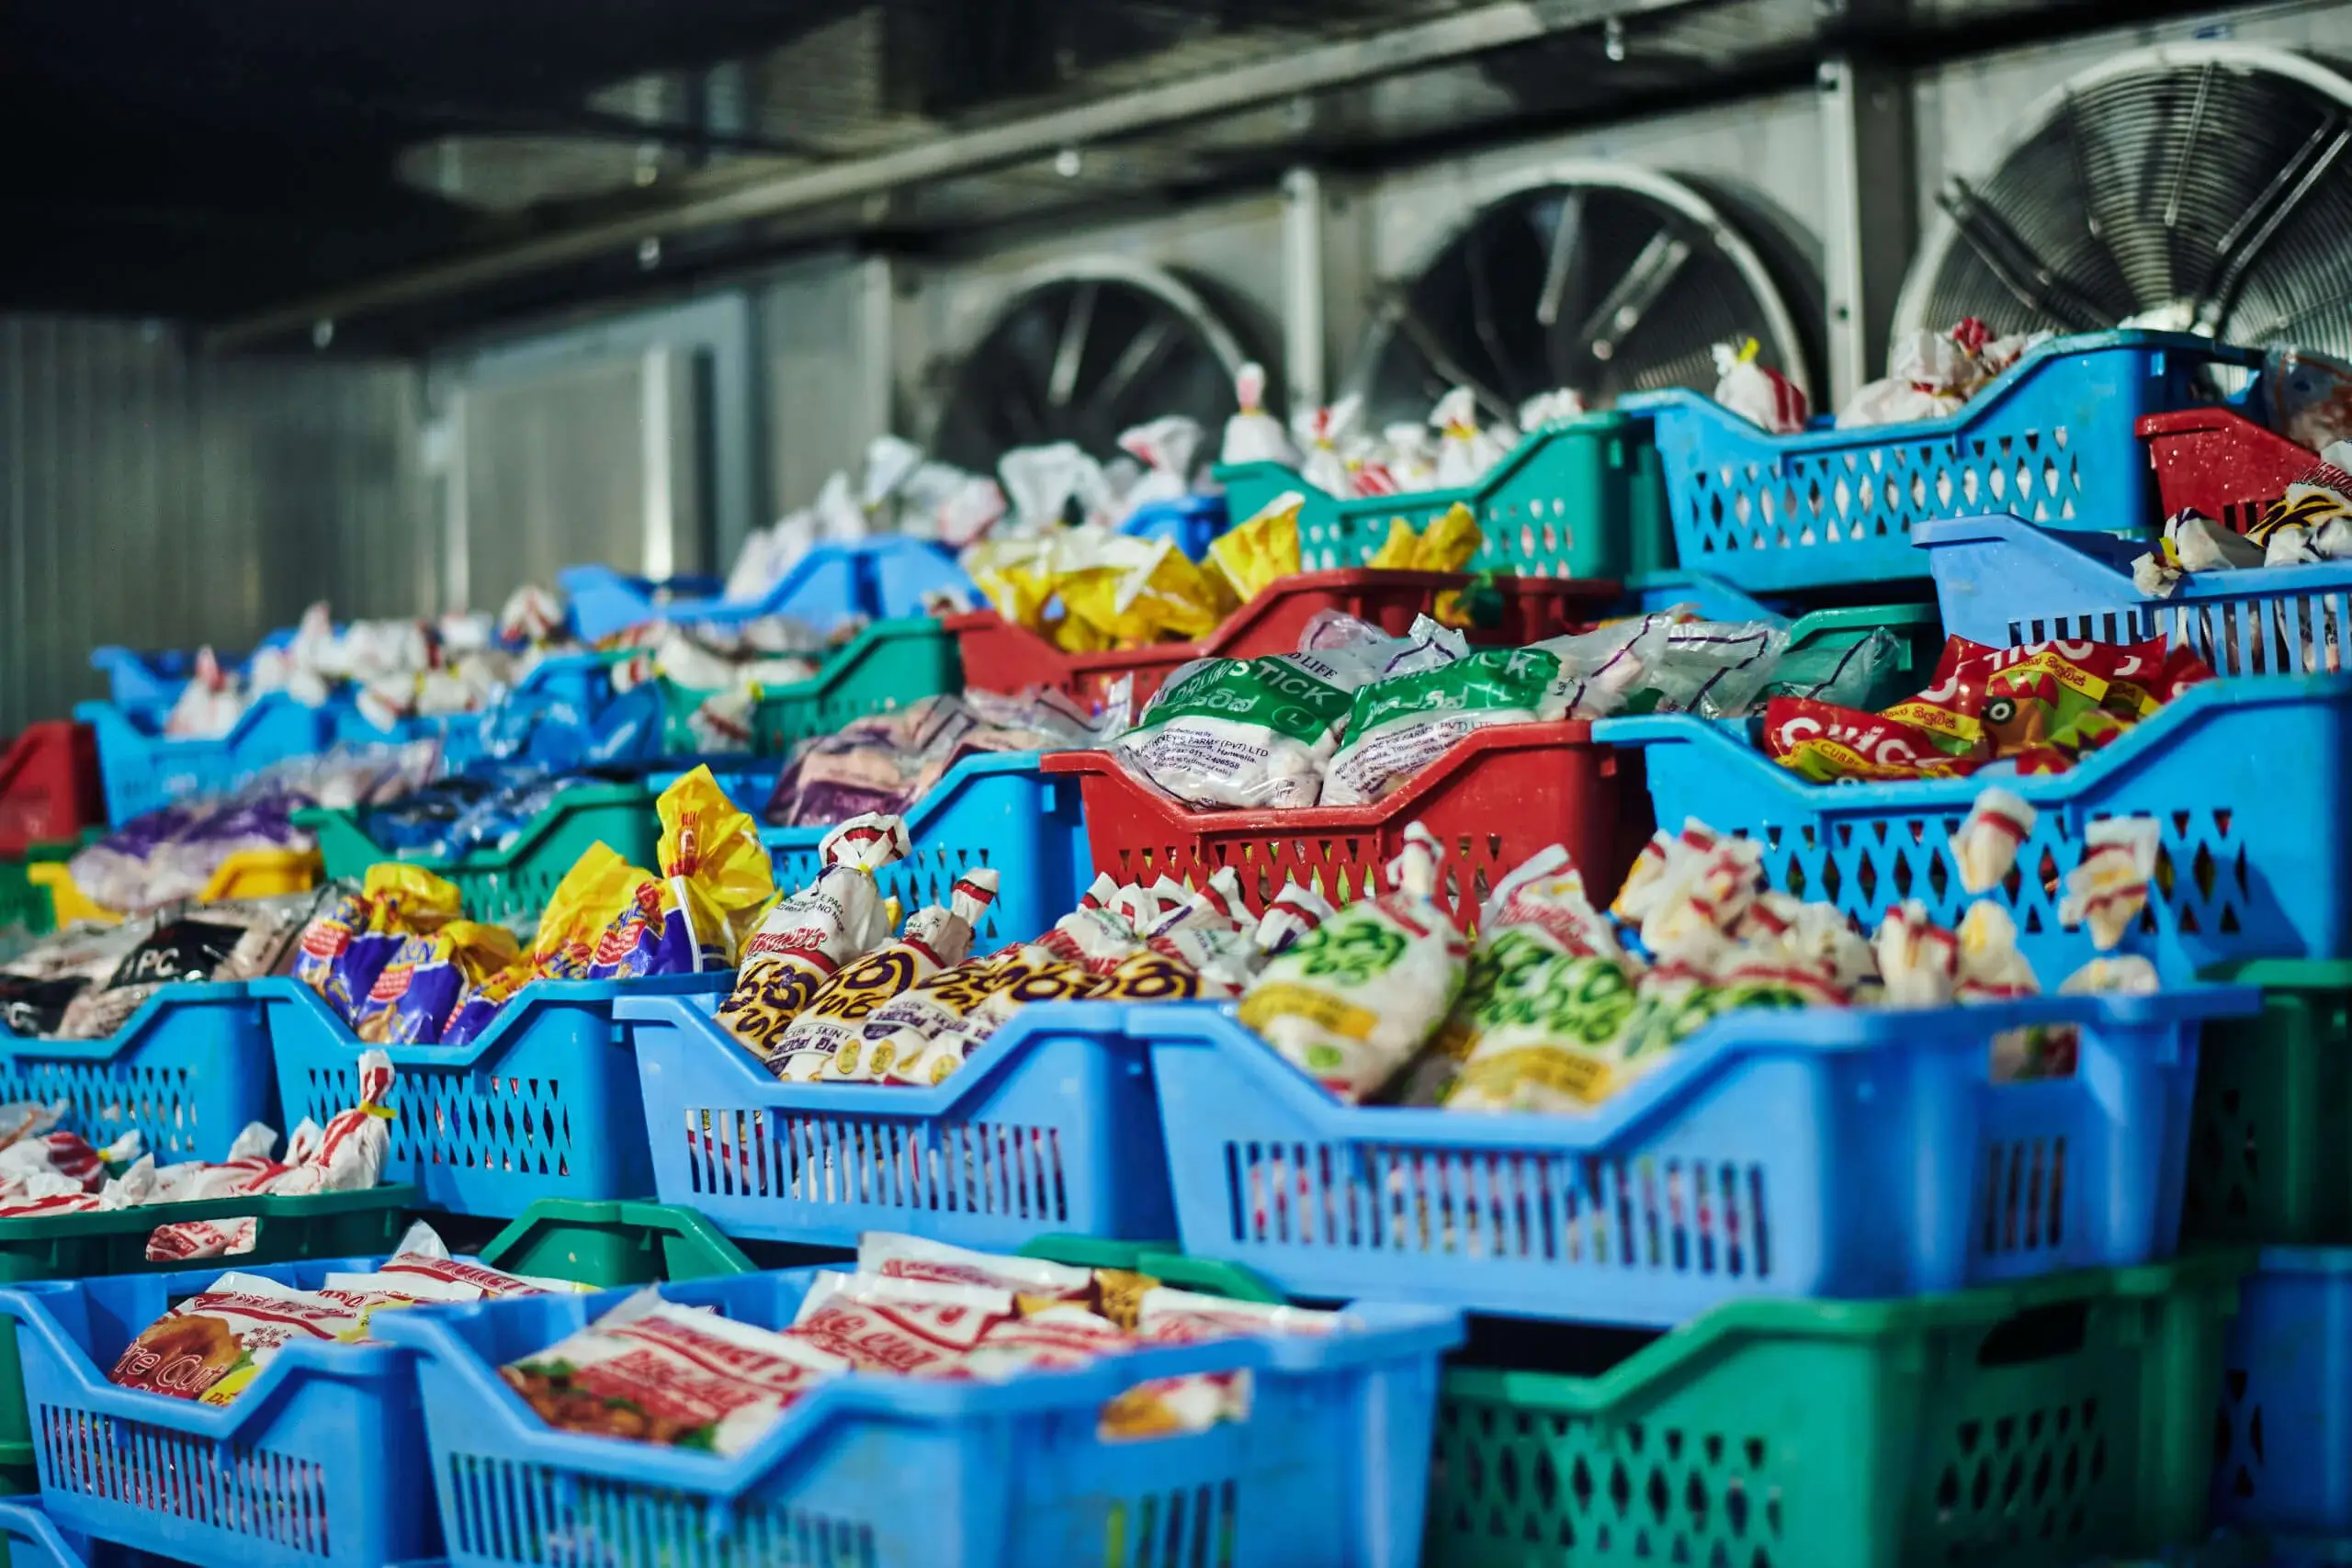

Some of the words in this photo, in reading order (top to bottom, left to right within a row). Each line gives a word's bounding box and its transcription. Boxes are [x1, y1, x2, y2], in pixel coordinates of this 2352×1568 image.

[1298, 654, 1338, 680] LIFE
[1249, 746, 1270, 758] LTD
[815, 1025, 842, 1039] SKIN
